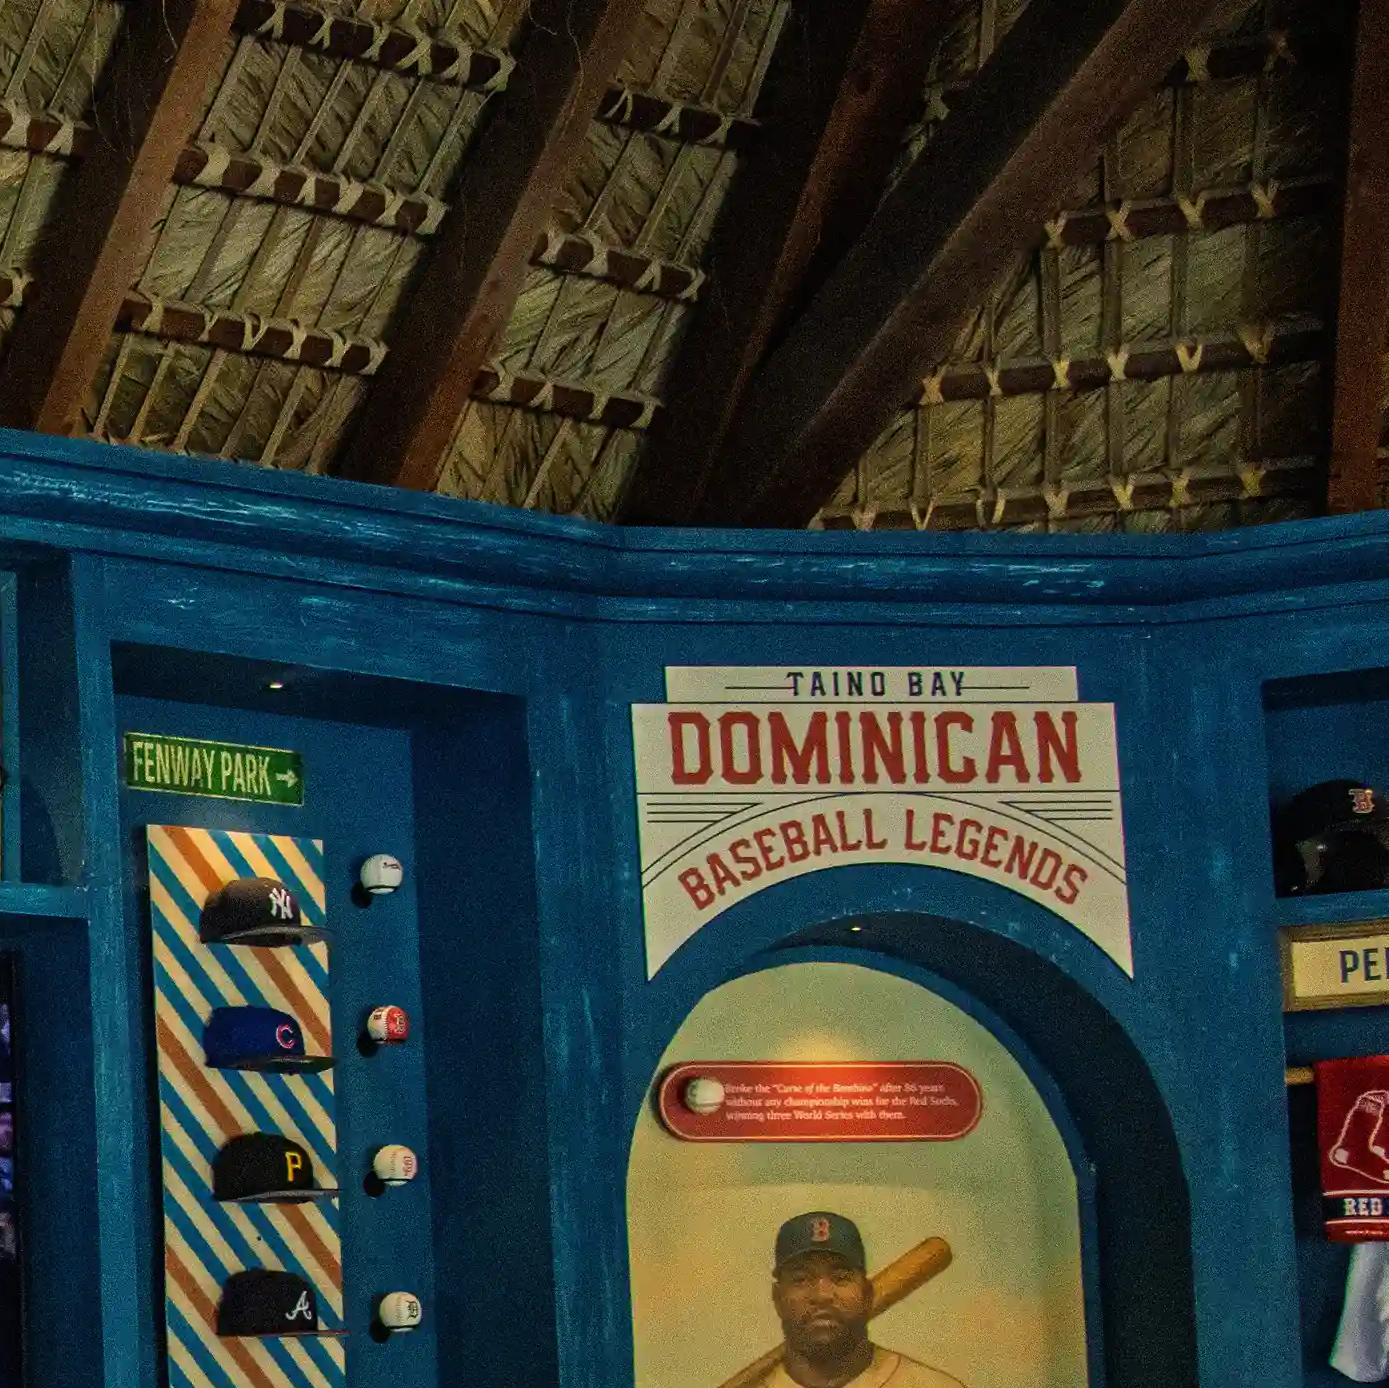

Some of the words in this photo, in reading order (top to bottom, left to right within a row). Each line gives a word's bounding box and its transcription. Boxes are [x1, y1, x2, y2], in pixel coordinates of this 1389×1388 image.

[788, 671, 886, 698] TAINO
[908, 670, 965, 698] BAY
[667, 710, 1084, 787] DOMINICAN
[131, 741, 215, 790] FENWAY
[221, 753, 272, 796] PARK
[677, 808, 888, 911] BASEBALL
[904, 808, 1089, 905] LEGENDS
[269, 888, 293, 920] NY
[276, 1023, 295, 1050] C
[285, 1150, 302, 1182] P
[1343, 1198, 1383, 1216] RED
[286, 1290, 312, 1320] A
